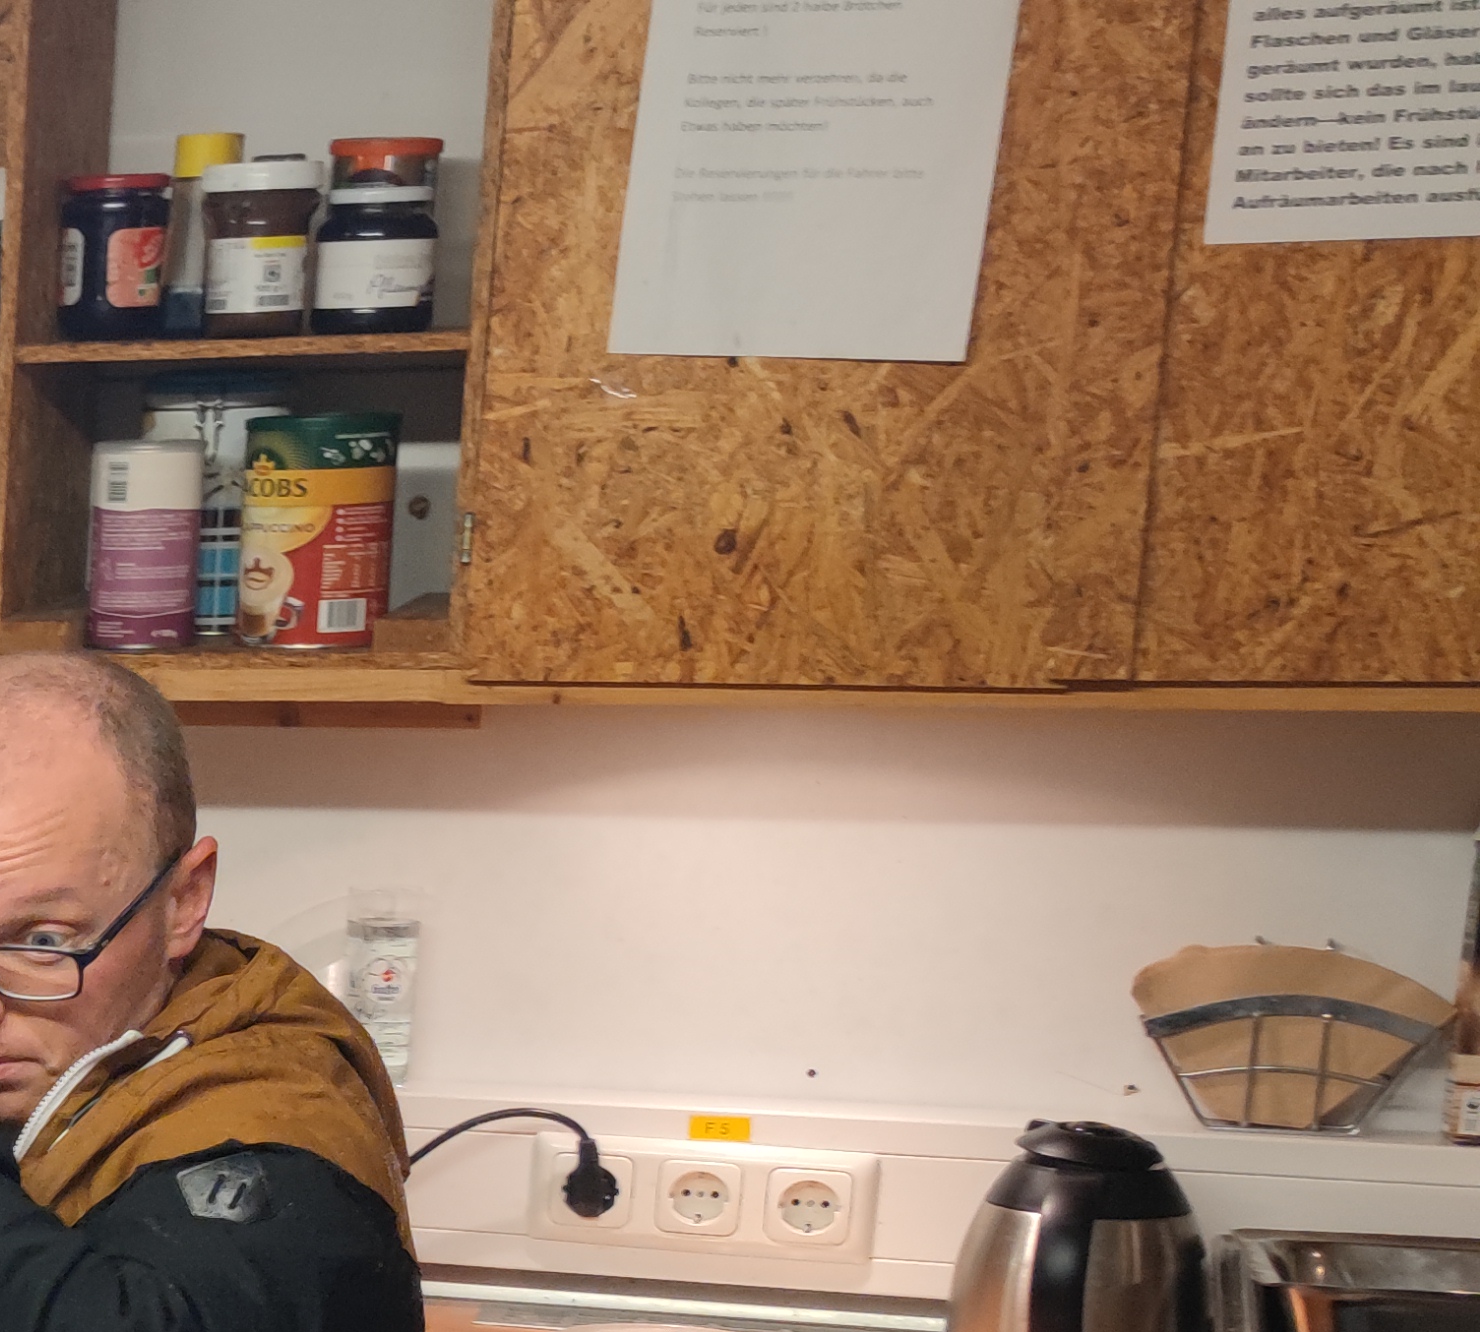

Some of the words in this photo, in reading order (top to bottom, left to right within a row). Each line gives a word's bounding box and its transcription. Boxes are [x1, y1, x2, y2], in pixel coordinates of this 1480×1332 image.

[1253, 7, 1306, 21] alles
[1313, 2, 1442, 20] aufgeräumt
[1251, 33, 1350, 48] Flaschen
[1358, 29, 1399, 43] und
[1407, 26, 1478, 40] Gläser
[1247, 60, 1340, 79] geräumt
[1347, 55, 1437, 69] wurden,
[1244, 89, 1306, 102] sollte
[1313, 86, 1359, 99] sich
[1367, 84, 1406, 97] das
[1414, 82, 1440, 94] im
[1238, 146, 1264, 156] an
[1271, 144, 1296, 155] zu
[1388, 136, 1414, 150] Es
[1421, 134, 1470, 149] sind
[1234, 166, 1365, 182] Mitarbeiter,
[1371, 164, 1406, 177] die
[1413, 162, 1468, 175] nach
[1231, 192, 1419, 209] Aufräumarbeiten
